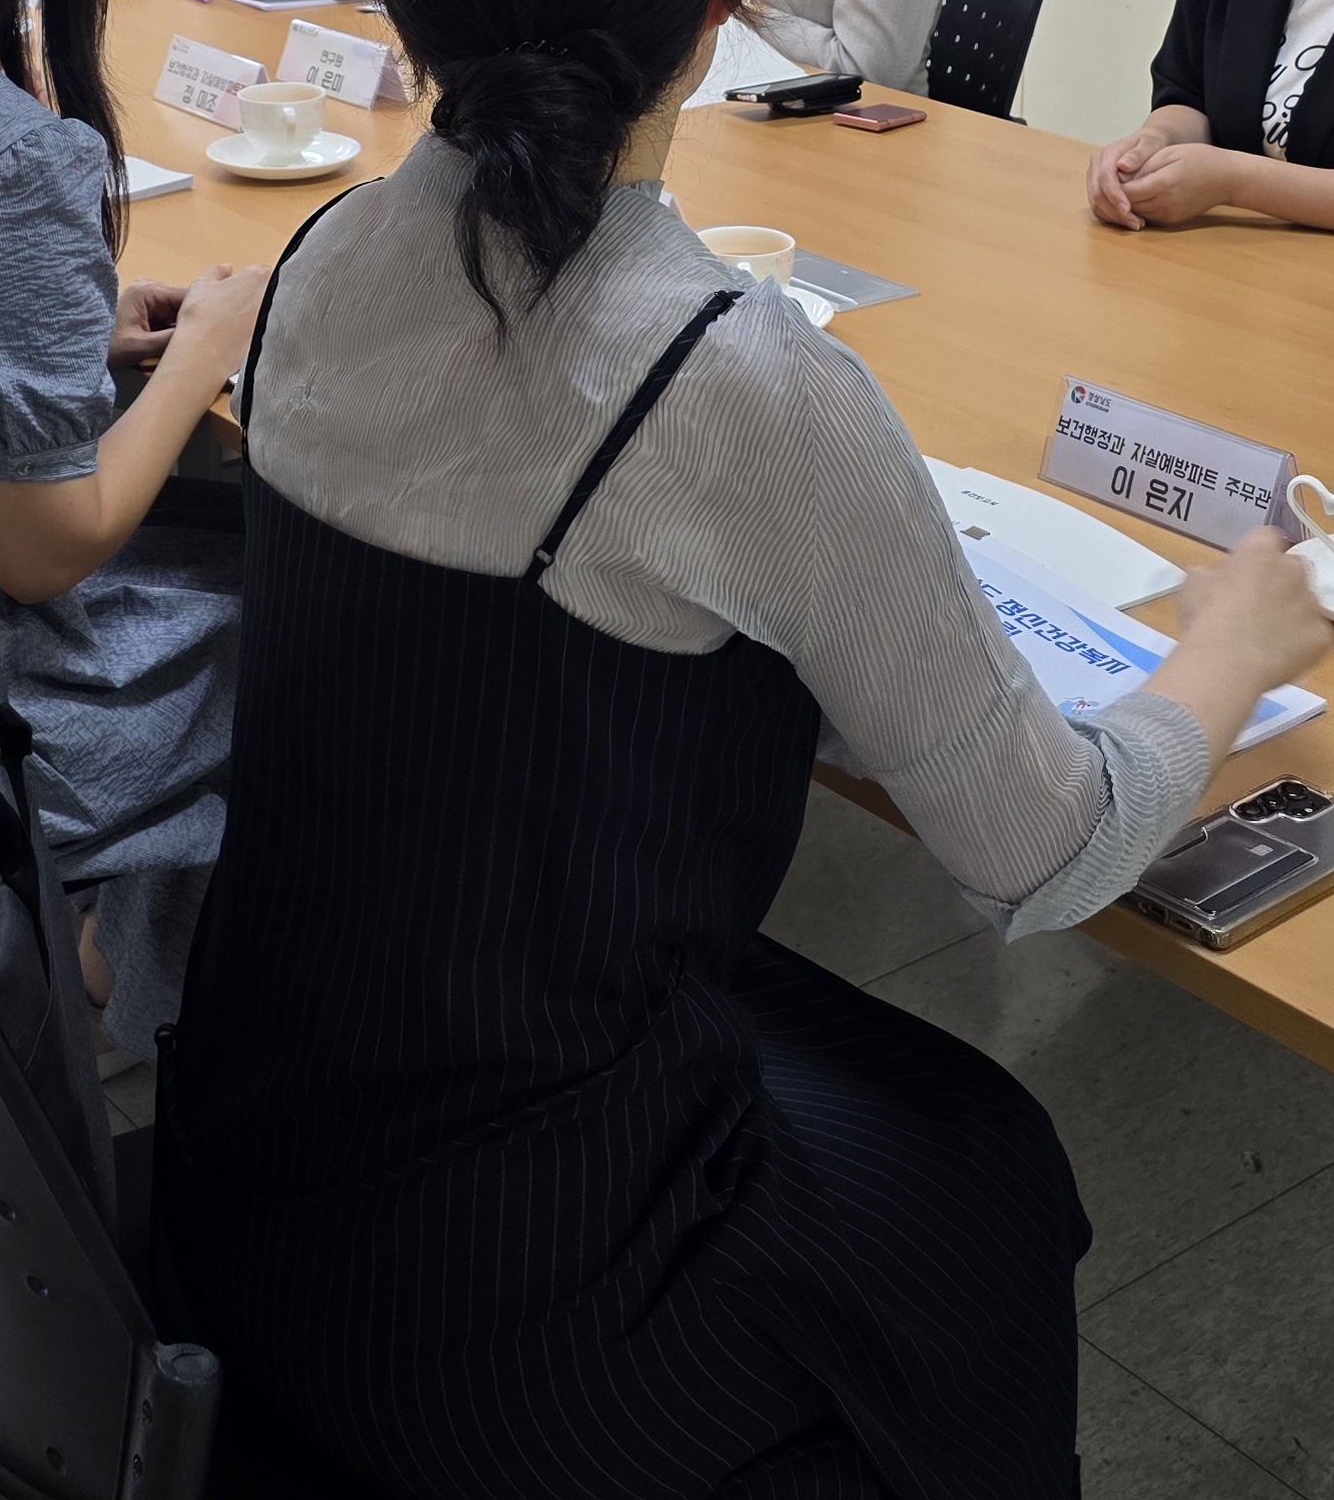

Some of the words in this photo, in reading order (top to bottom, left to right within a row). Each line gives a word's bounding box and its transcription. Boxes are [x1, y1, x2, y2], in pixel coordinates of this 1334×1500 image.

[306, 65, 320, 85] 이
[1088, 391, 1112, 408] 경상남도
[1056, 415, 1125, 456] 보건행정과
[1130, 442, 1219, 491] 자살예방파트
[1224, 476, 1272, 510] 주무관
[1110, 466, 1136, 499] 이
[1145, 478, 1194, 522] 은지
[995, 598, 1132, 676] 정신건강복지
